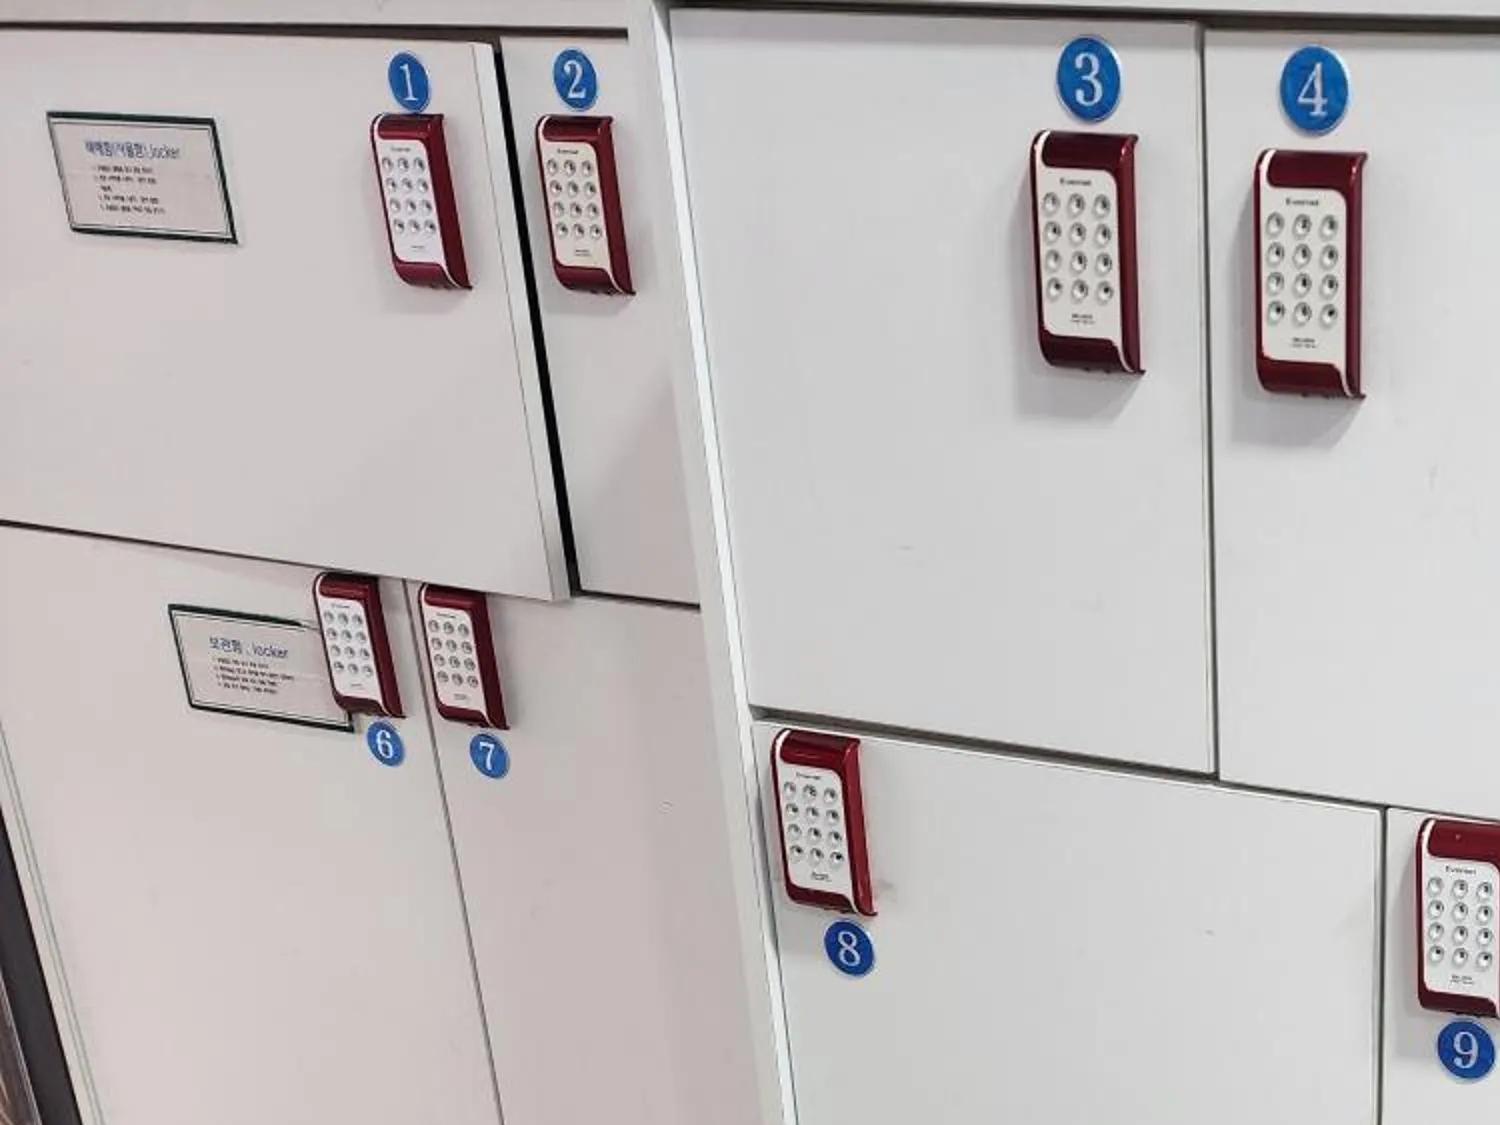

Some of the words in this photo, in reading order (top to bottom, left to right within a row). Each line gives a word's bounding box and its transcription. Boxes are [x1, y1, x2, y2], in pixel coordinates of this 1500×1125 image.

[399, 64, 418, 101] 1
[563, 59, 586, 100] 2
[1074, 52, 1103, 106] 3
[1297, 61, 1329, 117] 4
[375, 729, 393, 760] 6
[478, 742, 496, 771] 7
[837, 930, 861, 967] 8
[1452, 1031, 1479, 1069] 9
